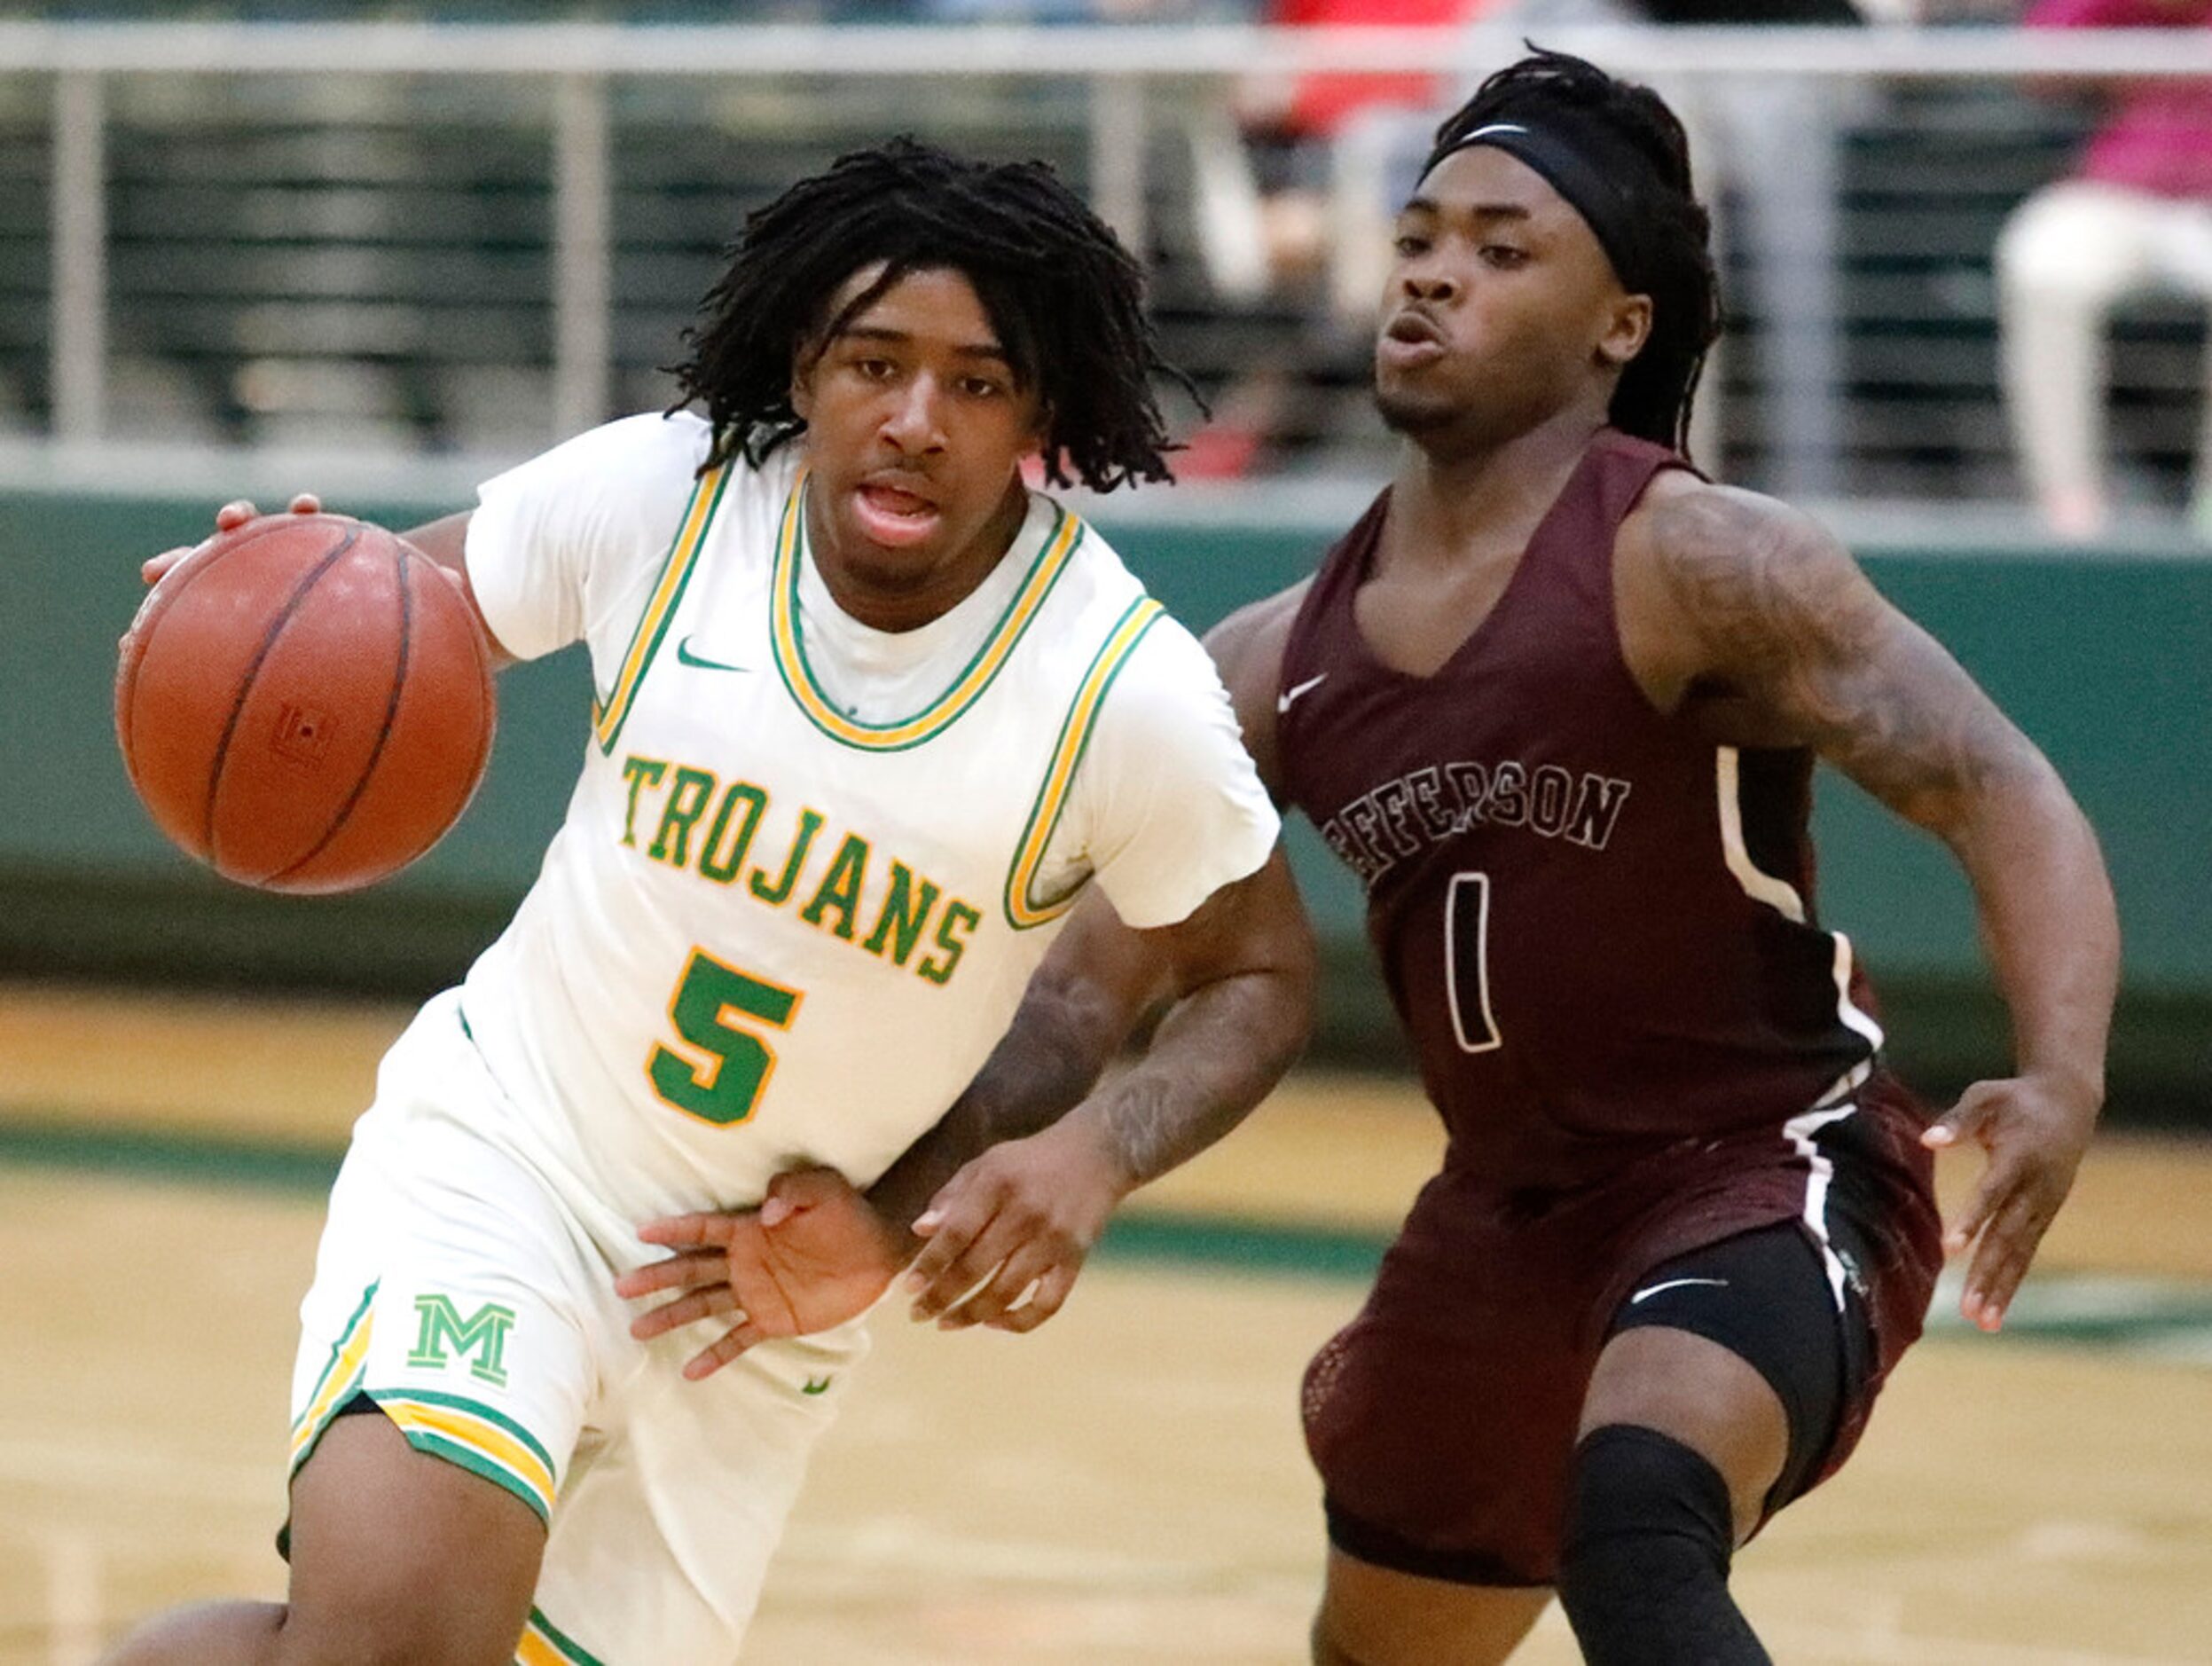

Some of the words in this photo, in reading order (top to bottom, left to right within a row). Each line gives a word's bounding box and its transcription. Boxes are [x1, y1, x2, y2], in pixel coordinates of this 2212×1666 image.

[621, 755, 982, 987] TROJANS
[644, 945, 804, 1129] 5
[1445, 872, 1502, 1053] 1
[407, 1293, 516, 1387] M
